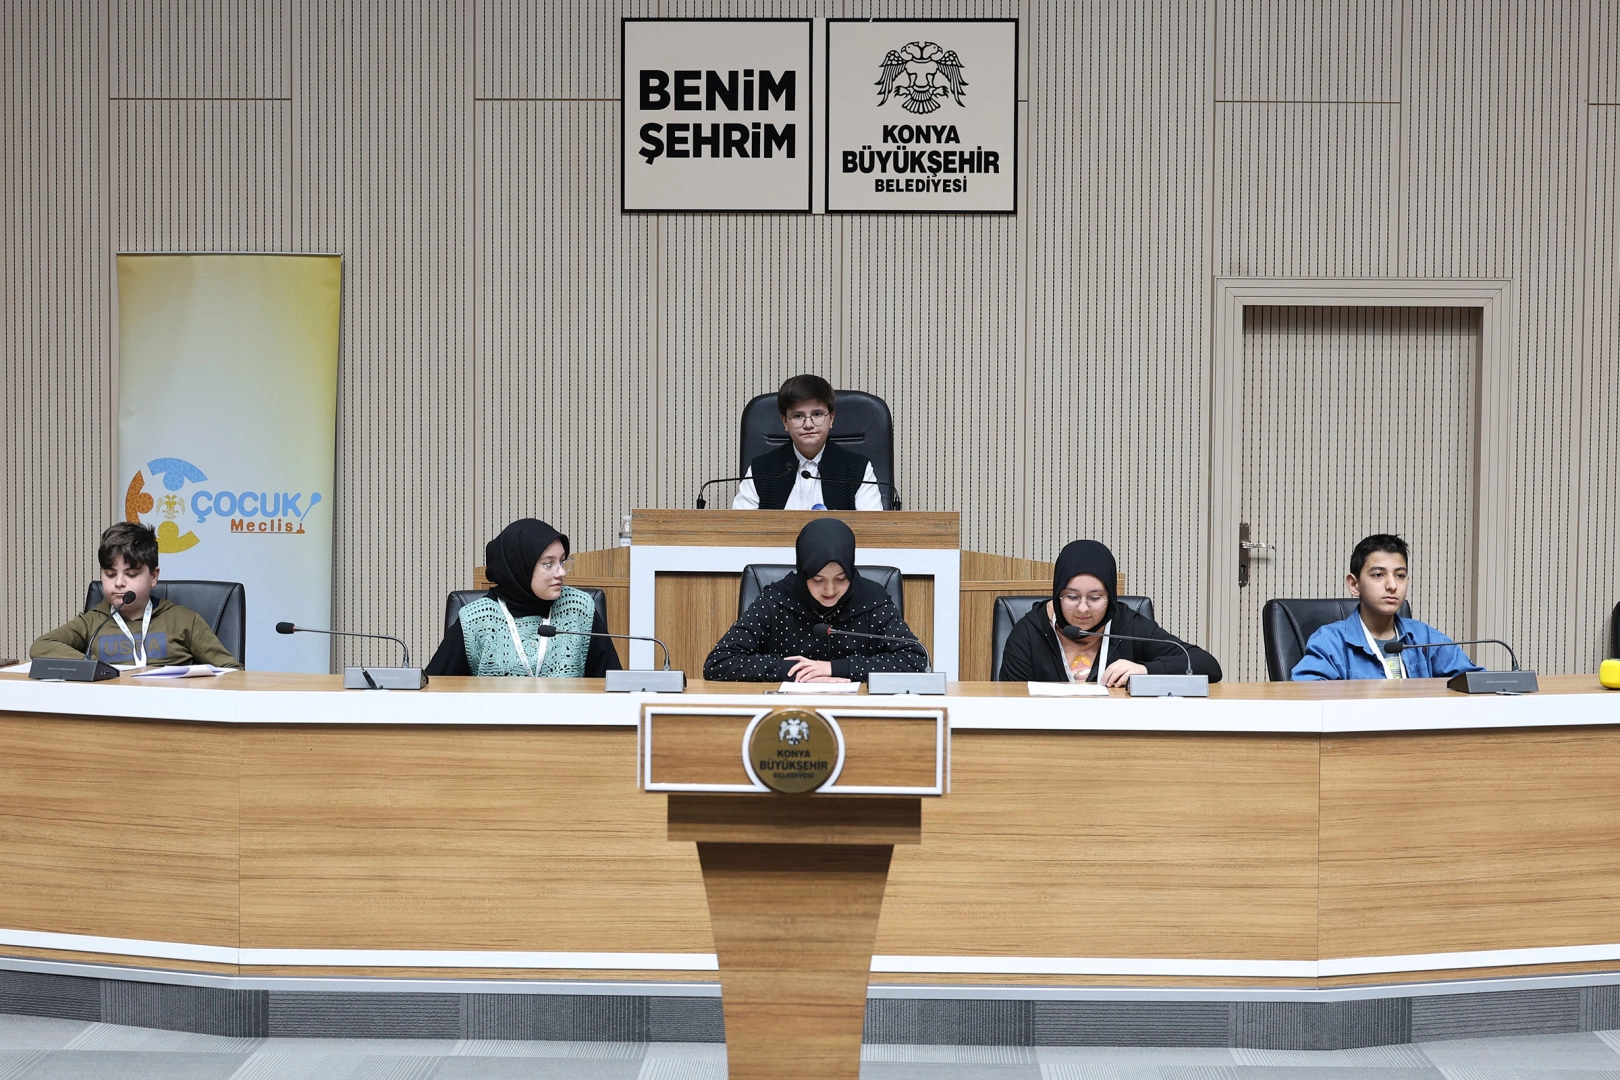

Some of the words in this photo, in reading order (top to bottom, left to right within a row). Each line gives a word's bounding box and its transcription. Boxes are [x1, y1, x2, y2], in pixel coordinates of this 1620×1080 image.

[882, 125, 960, 144] KONYA
[842, 145, 1000, 177] BÜYÜKŞEHİR
[875, 177, 968, 193] BELEDİYESİ
[191, 490, 302, 523] ÇOCUK
[777, 750, 811, 758] KONYA
